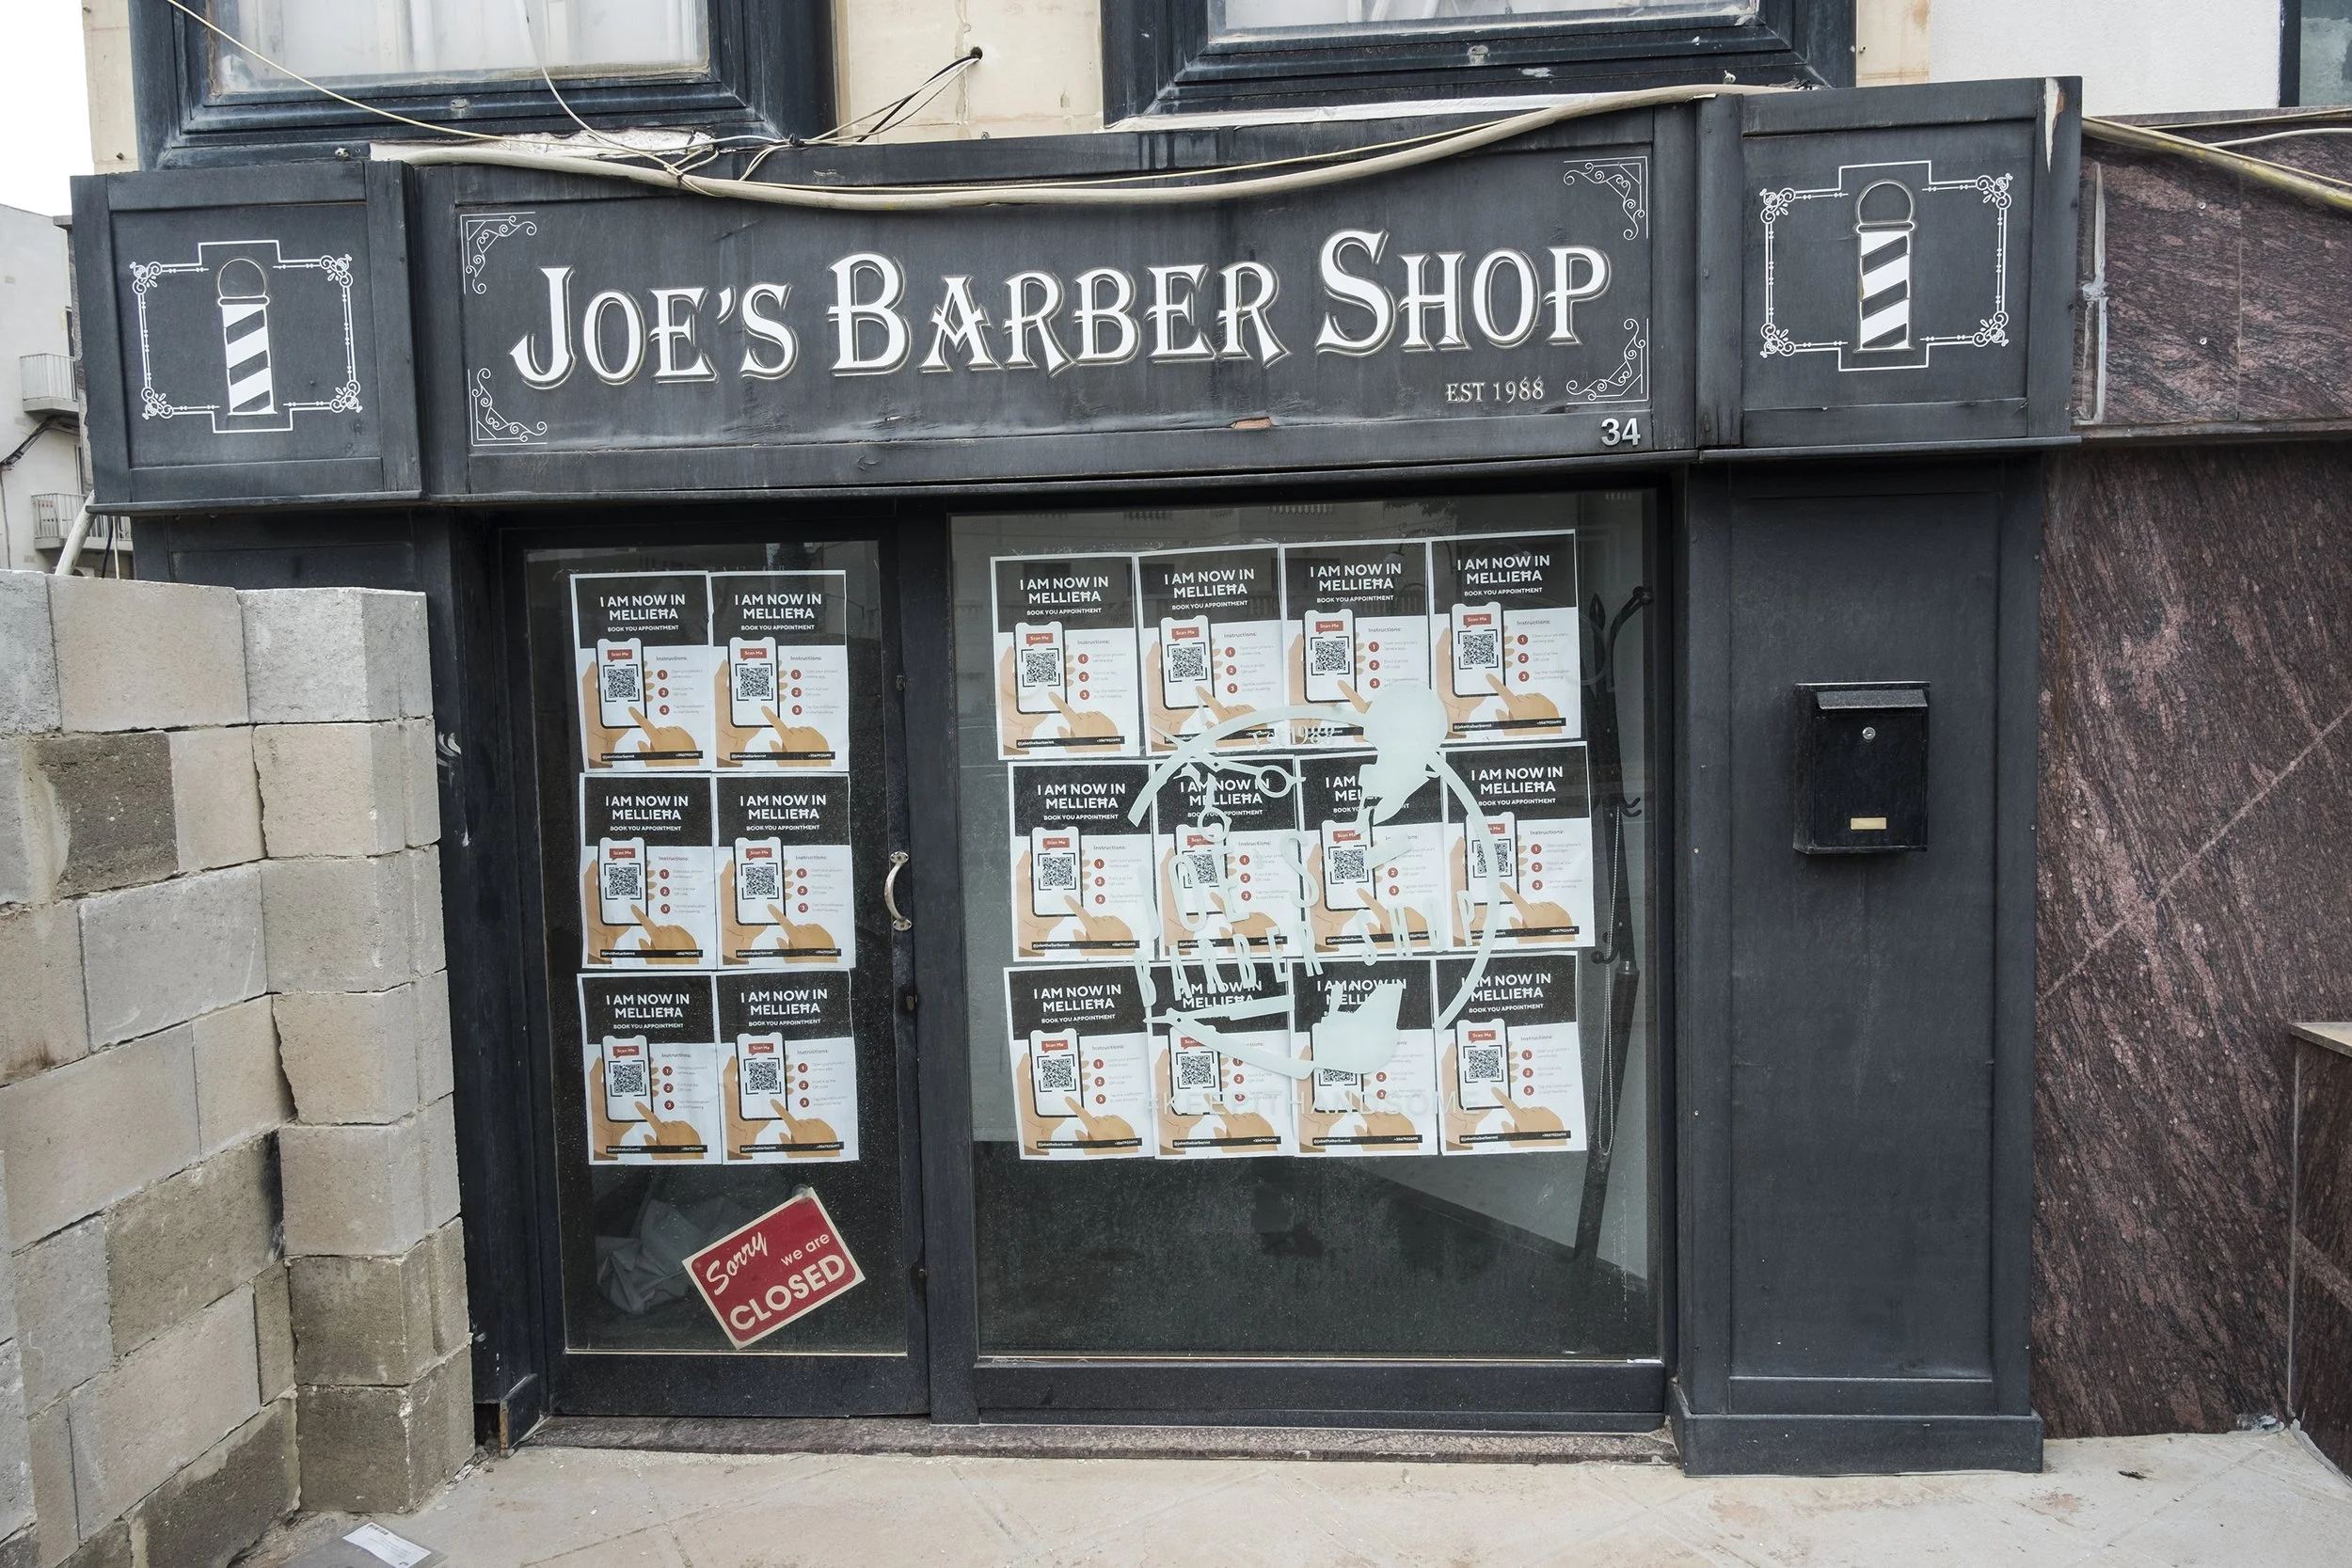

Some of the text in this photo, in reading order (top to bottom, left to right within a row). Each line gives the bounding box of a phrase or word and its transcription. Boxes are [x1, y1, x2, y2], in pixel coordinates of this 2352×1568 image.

[508, 228, 1612, 390] JOE'S BARBER SHOP
[1446, 376, 1545, 404] EST 1988
[1600, 417, 1642, 447] 34
[1457, 554, 1550, 571] I AM NOW IN
[1164, 567, 1255, 585] I AM NOW IN
[1310, 562, 1402, 578] I AM NOW IN
[1019, 576, 1109, 591] I AM NOW IN
[1497, 586, 1543, 594] APPOINTMENT
[599, 594, 685, 608] I AM NOW IN
[735, 593, 822, 606] I AM NOW IN
[1203, 599, 1248, 609] APPOINTMENT
[1470, 766, 1564, 782] I AM NOW IN
[1180, 782, 1184, 793] I
[1325, 775, 1356, 788] I AM
[1037, 783, 1126, 796] I AM NOW IN
[604, 795, 689, 807] I AM NOW IN
[739, 794, 826, 807] I AM NOW IN
[1511, 797, 1556, 805] APPOINTMENT
[1317, 980, 1321, 992] I
[1494, 974, 1533, 987] NOW
[1535, 973, 1551, 985] IN
[740, 989, 827, 1004] I AM NOW IN
[1033, 984, 1121, 1000] I AM NOW IN
[606, 993, 690, 1006] I AM NOW IN
[781, 1233, 831, 1267] we are
[706, 1231, 769, 1296] Sorry
[730, 1254, 846, 1331] CLOSED
